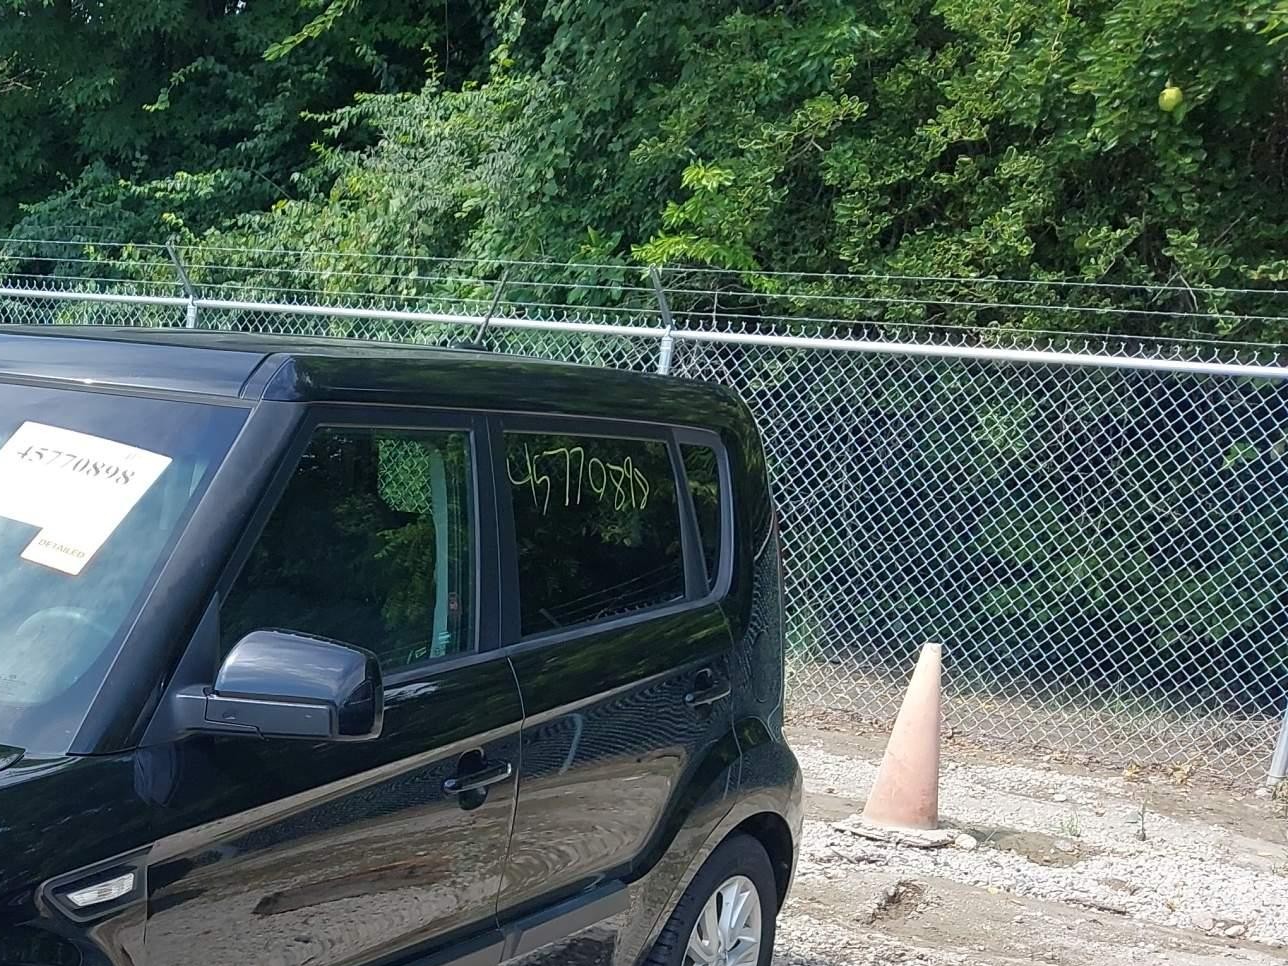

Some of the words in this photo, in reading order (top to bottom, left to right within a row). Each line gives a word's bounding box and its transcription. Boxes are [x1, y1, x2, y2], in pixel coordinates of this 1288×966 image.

[17, 445, 135, 485] 45770898
[506, 442, 650, 516] 45770898
[38, 538, 85, 559] DETAILED
